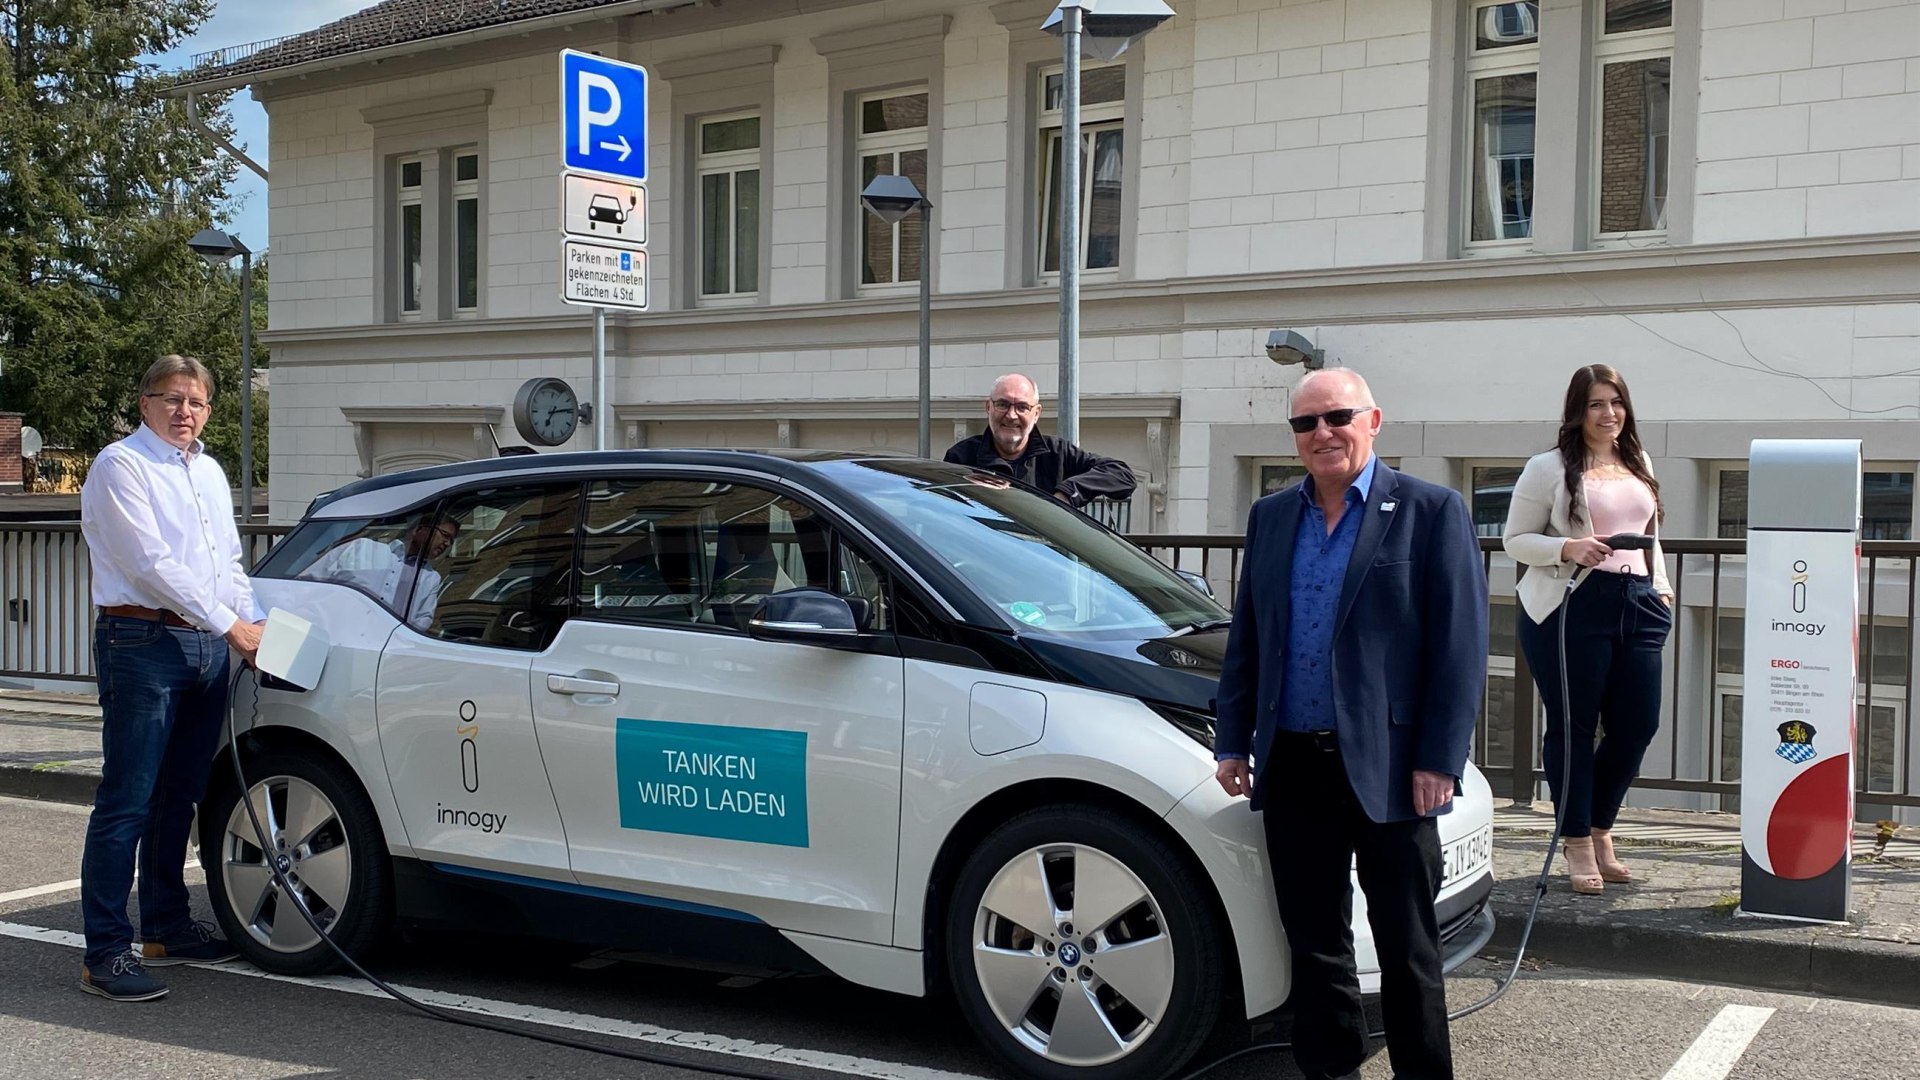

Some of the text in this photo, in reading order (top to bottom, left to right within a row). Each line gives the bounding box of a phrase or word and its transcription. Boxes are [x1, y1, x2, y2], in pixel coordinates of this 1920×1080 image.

[578, 70, 622, 156] P
[571, 248, 641, 270] Parken mit in
[568, 266, 643, 286] gekennzeichneten
[576, 282, 609, 299] Flächen
[613, 287, 618, 300] 4
[1771, 618, 1826, 636] innogy
[1771, 659, 1800, 669] ERGO
[662, 749, 756, 780] TANKEN
[637, 780, 785, 817] WIRD LADEN
[437, 802, 507, 834] innogy
